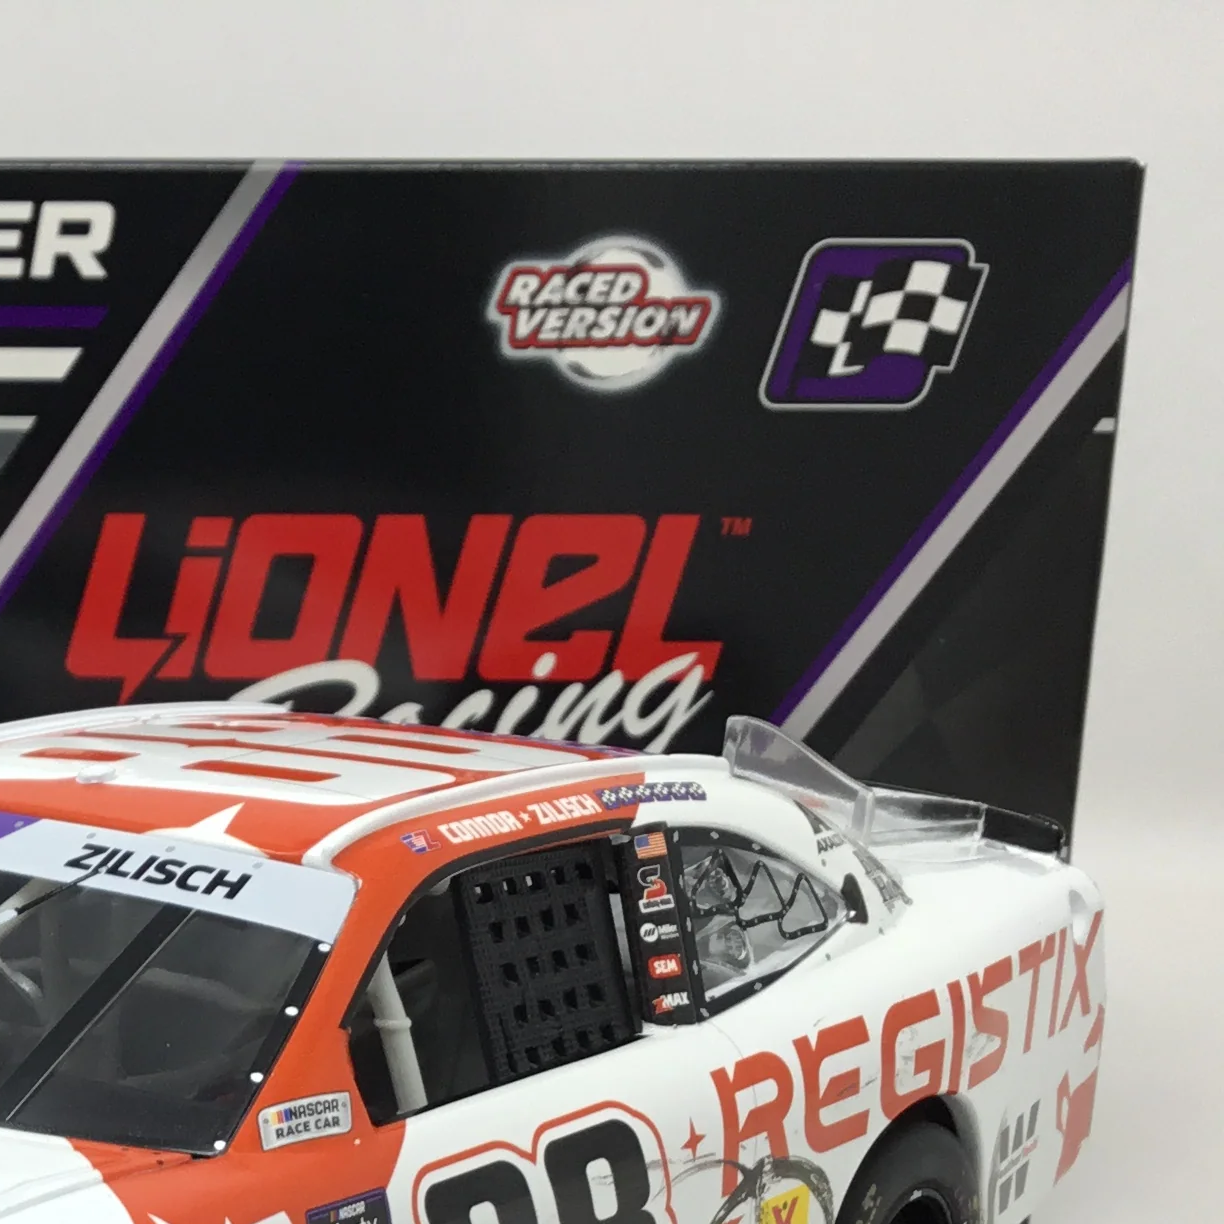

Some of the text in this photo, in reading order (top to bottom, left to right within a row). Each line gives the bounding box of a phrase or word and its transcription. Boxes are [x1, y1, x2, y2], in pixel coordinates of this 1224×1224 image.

[504, 270, 644, 306] RACED
[514, 304, 705, 341] VERSION
[437, 792, 603, 845] CONNOR ZILISCH
[63, 842, 253, 900] ZILISCH
[653, 959, 679, 975] SEM
[711, 908, 1105, 1198] REGISTIX
[289, 1098, 340, 1120] NASCAR
[275, 1116, 341, 1140] RACE CAR
